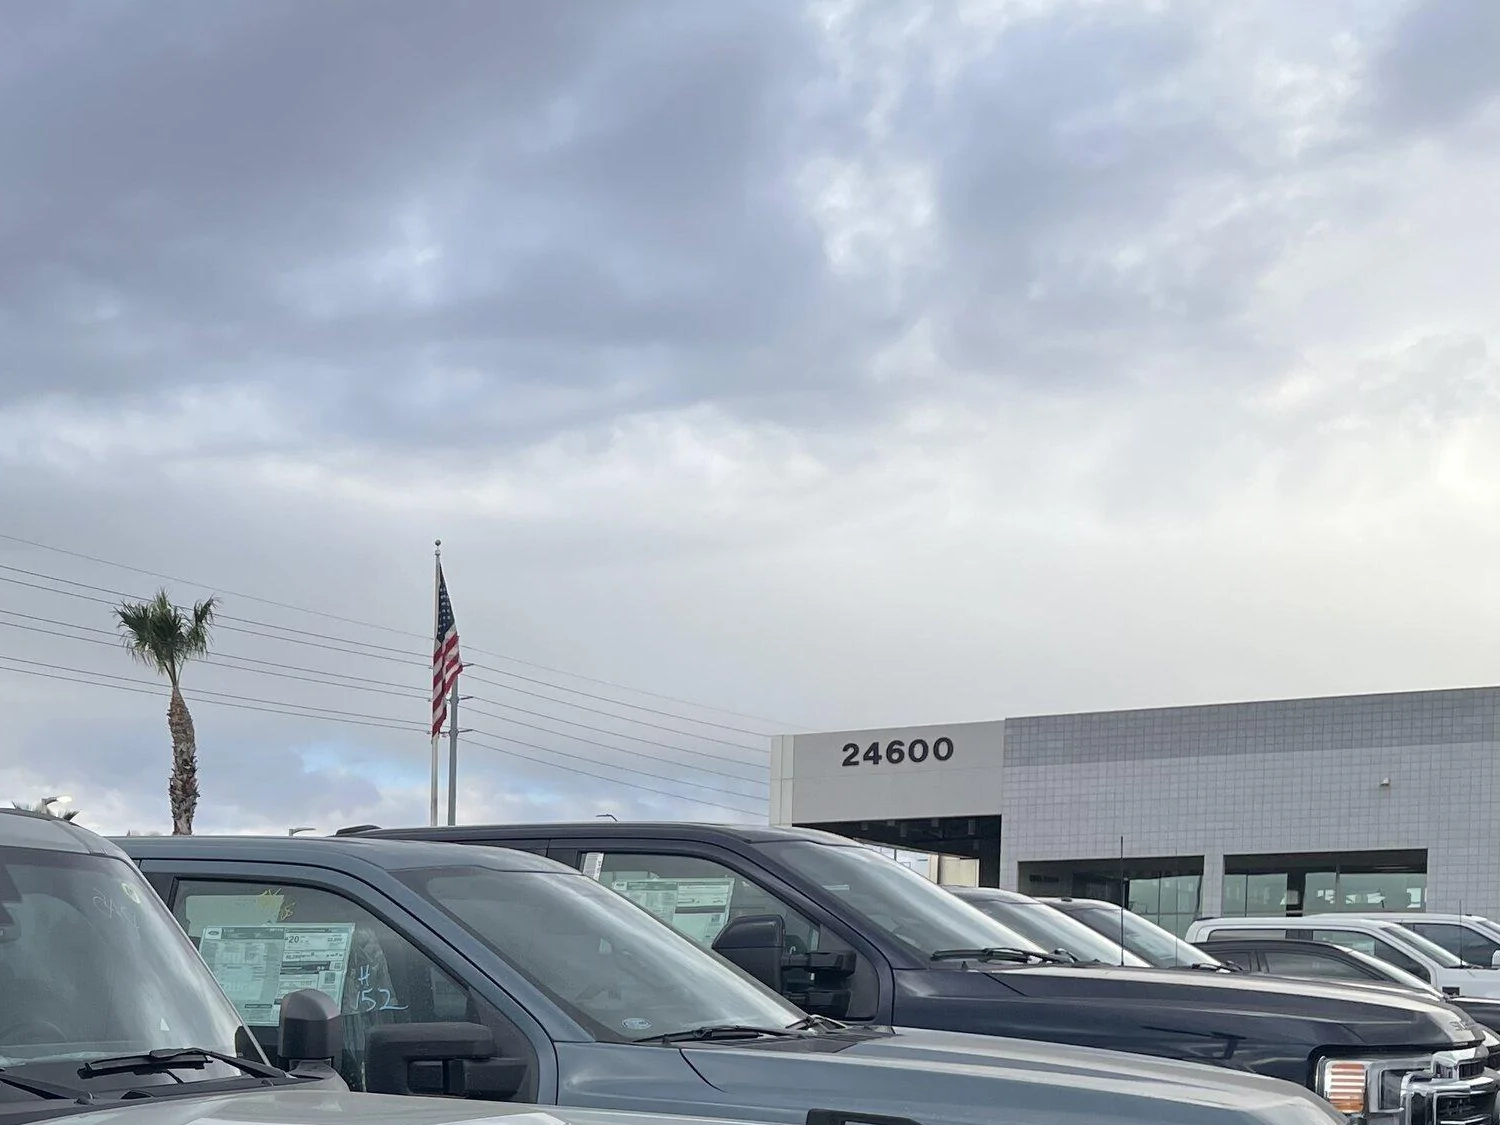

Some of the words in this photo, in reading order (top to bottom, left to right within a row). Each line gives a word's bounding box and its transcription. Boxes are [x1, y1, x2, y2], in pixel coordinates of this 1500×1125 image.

[842, 737, 954, 766] 24600
[288, 935, 300, 944] 20
[352, 987, 409, 1012] 152
